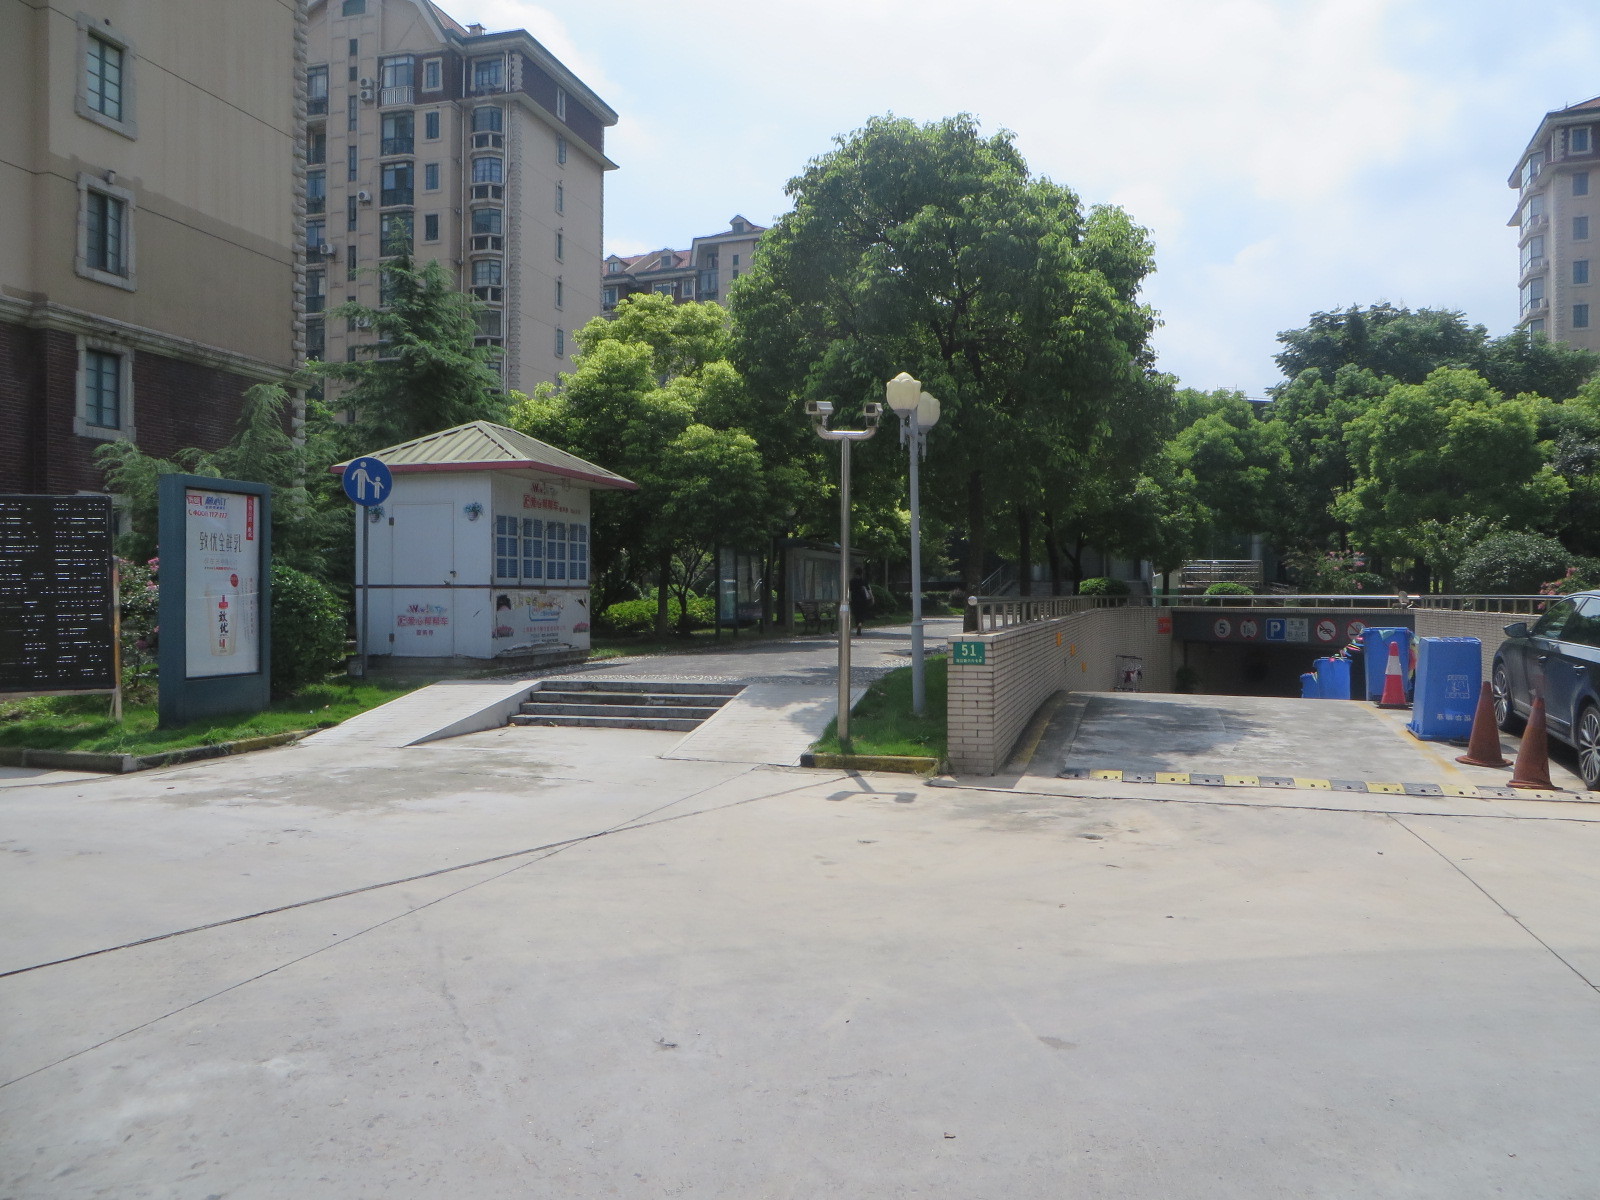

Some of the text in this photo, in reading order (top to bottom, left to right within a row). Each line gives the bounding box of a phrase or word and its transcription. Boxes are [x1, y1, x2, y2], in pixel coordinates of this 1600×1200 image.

[199, 531, 242, 553] 致优全鲜乳
[1219, 623, 1226, 635] 5
[1270, 621, 1281, 637] P
[961, 644, 976, 656] 51
